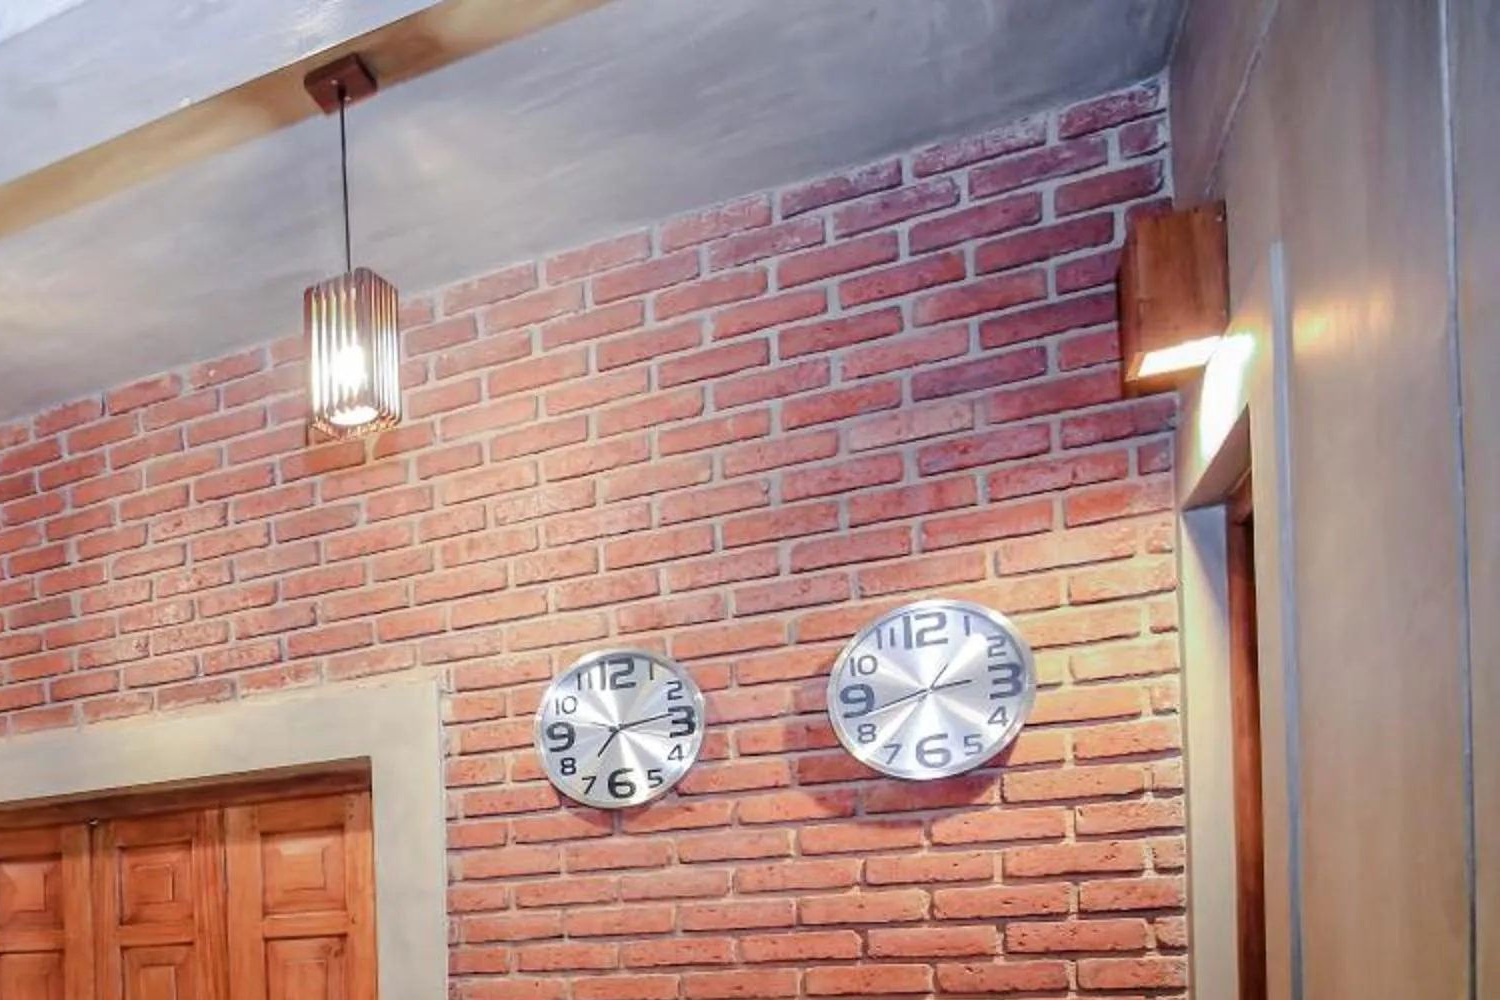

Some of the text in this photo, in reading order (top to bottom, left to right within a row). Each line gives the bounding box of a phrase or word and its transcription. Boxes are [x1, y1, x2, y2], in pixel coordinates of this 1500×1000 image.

[903, 612, 948, 649] 12
[964, 616, 970, 636] 1
[876, 627, 895, 650] 11
[987, 635, 1006, 657] 2
[600, 657, 636, 690] 12
[850, 655, 878, 676] 10
[577, 671, 592, 690] 11
[666, 681, 684, 700] 2
[988, 663, 1023, 699] 3
[555, 696, 578, 715] 10
[840, 684, 875, 718] 9
[668, 706, 696, 738] 3
[988, 706, 1008, 726] 4
[546, 722, 575, 752] 9
[857, 723, 877, 744] 8
[667, 744, 684, 761] 4
[883, 744, 902, 764] 7
[916, 733, 952, 768] 6
[963, 734, 983, 756] 5
[560, 758, 576, 776] 8
[582, 776, 596, 795] 7
[607, 768, 636, 798] 6
[647, 769, 664, 788] 5
